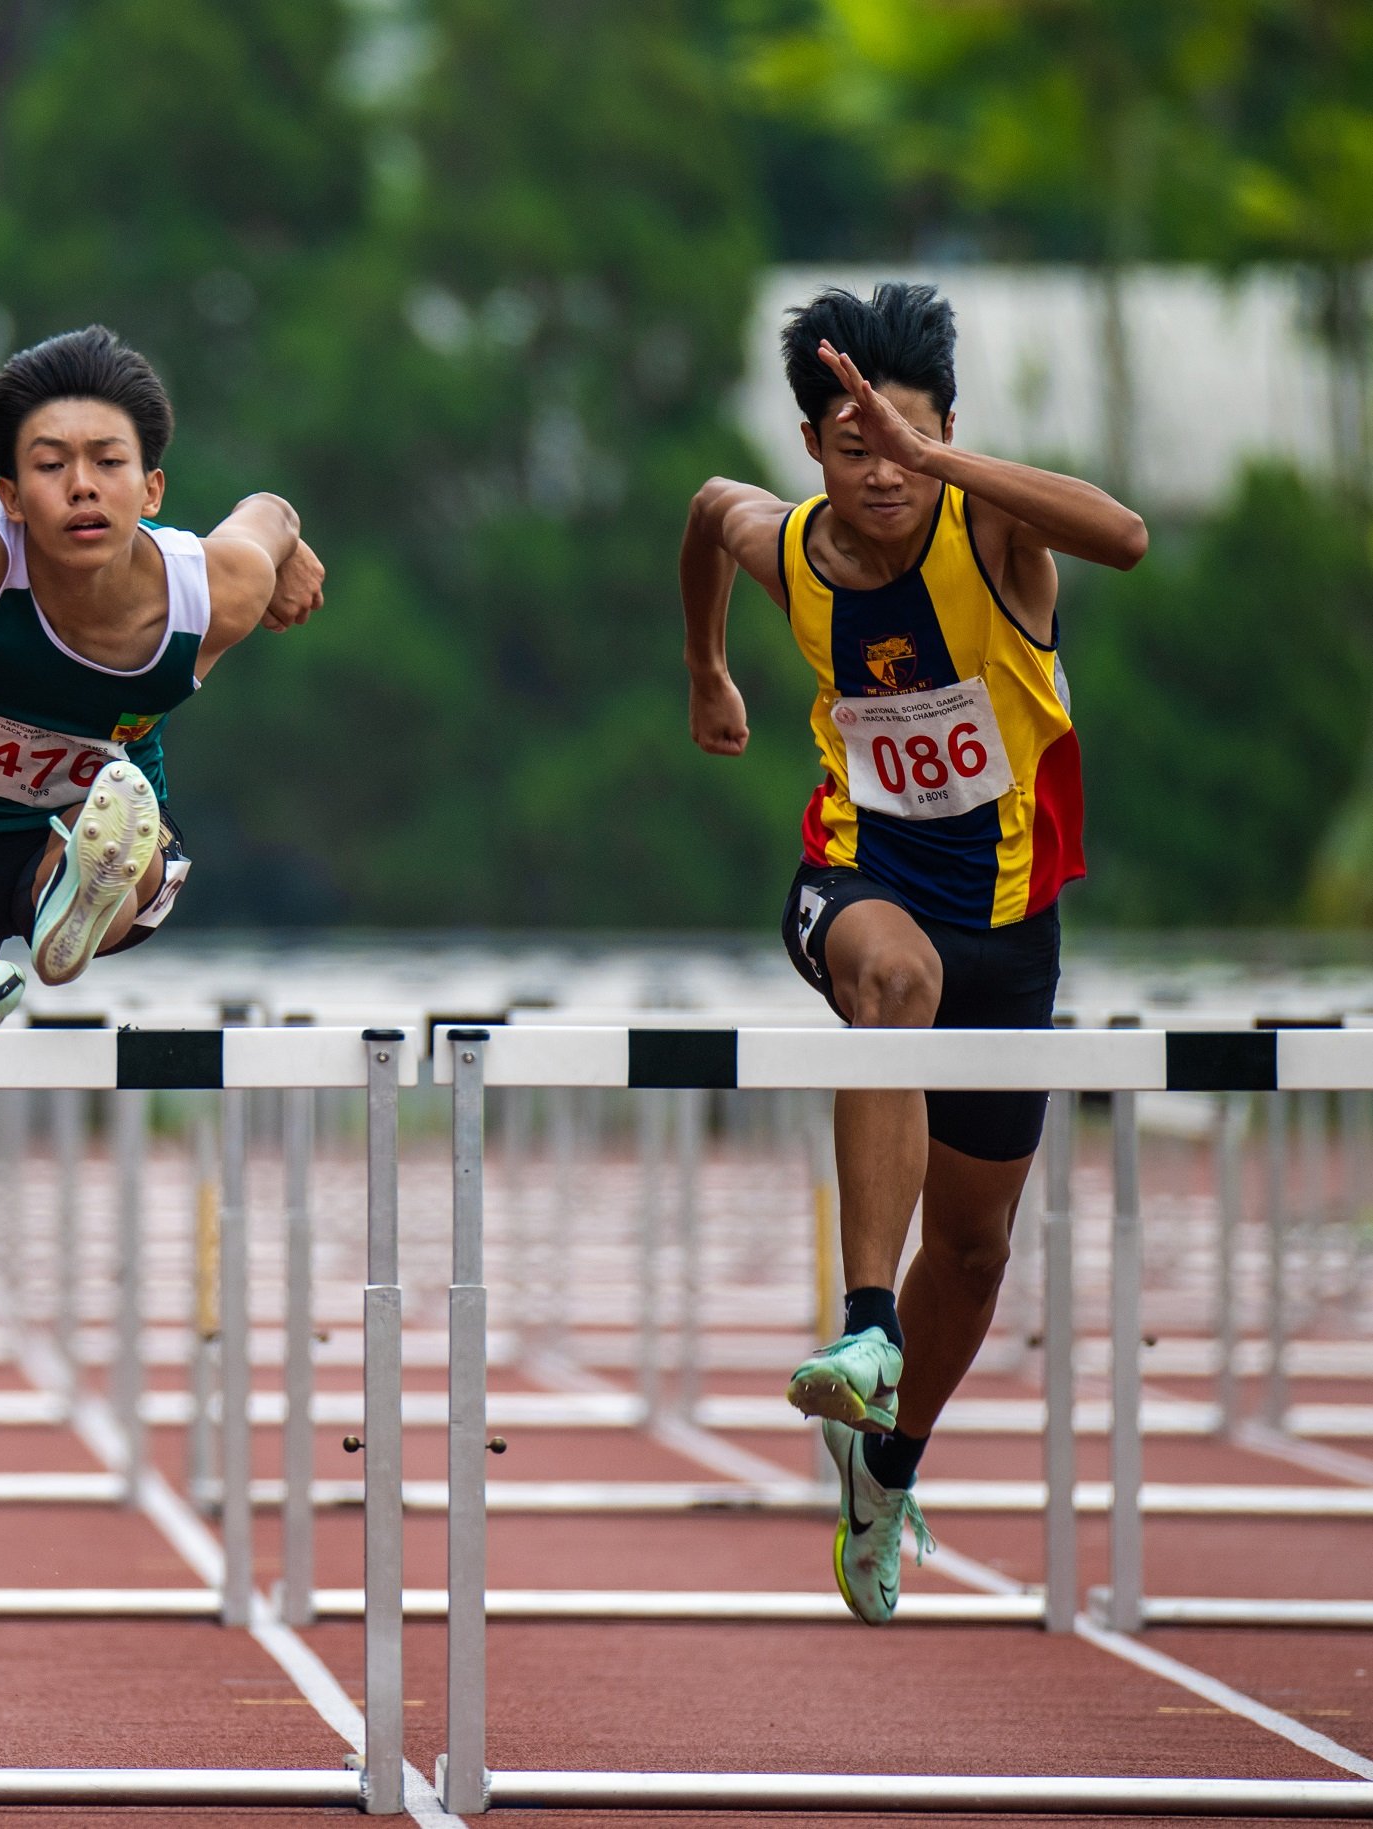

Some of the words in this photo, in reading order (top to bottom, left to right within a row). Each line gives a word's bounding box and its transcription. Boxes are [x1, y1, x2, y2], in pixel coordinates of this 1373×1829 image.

[865, 707, 899, 715] NATIONAL
[901, 703, 933, 713] SCHOOL
[936, 694, 964, 708] GAMES
[912, 698, 975, 721] CHAMPIONSHIPS
[5, 720, 42, 734] NATIONAL
[871, 722, 988, 795] 086
[20, 783, 27, 791] B
[27, 787, 50, 798] BOYS
[917, 794, 925, 804] B
[926, 789, 949, 803] BOYS
